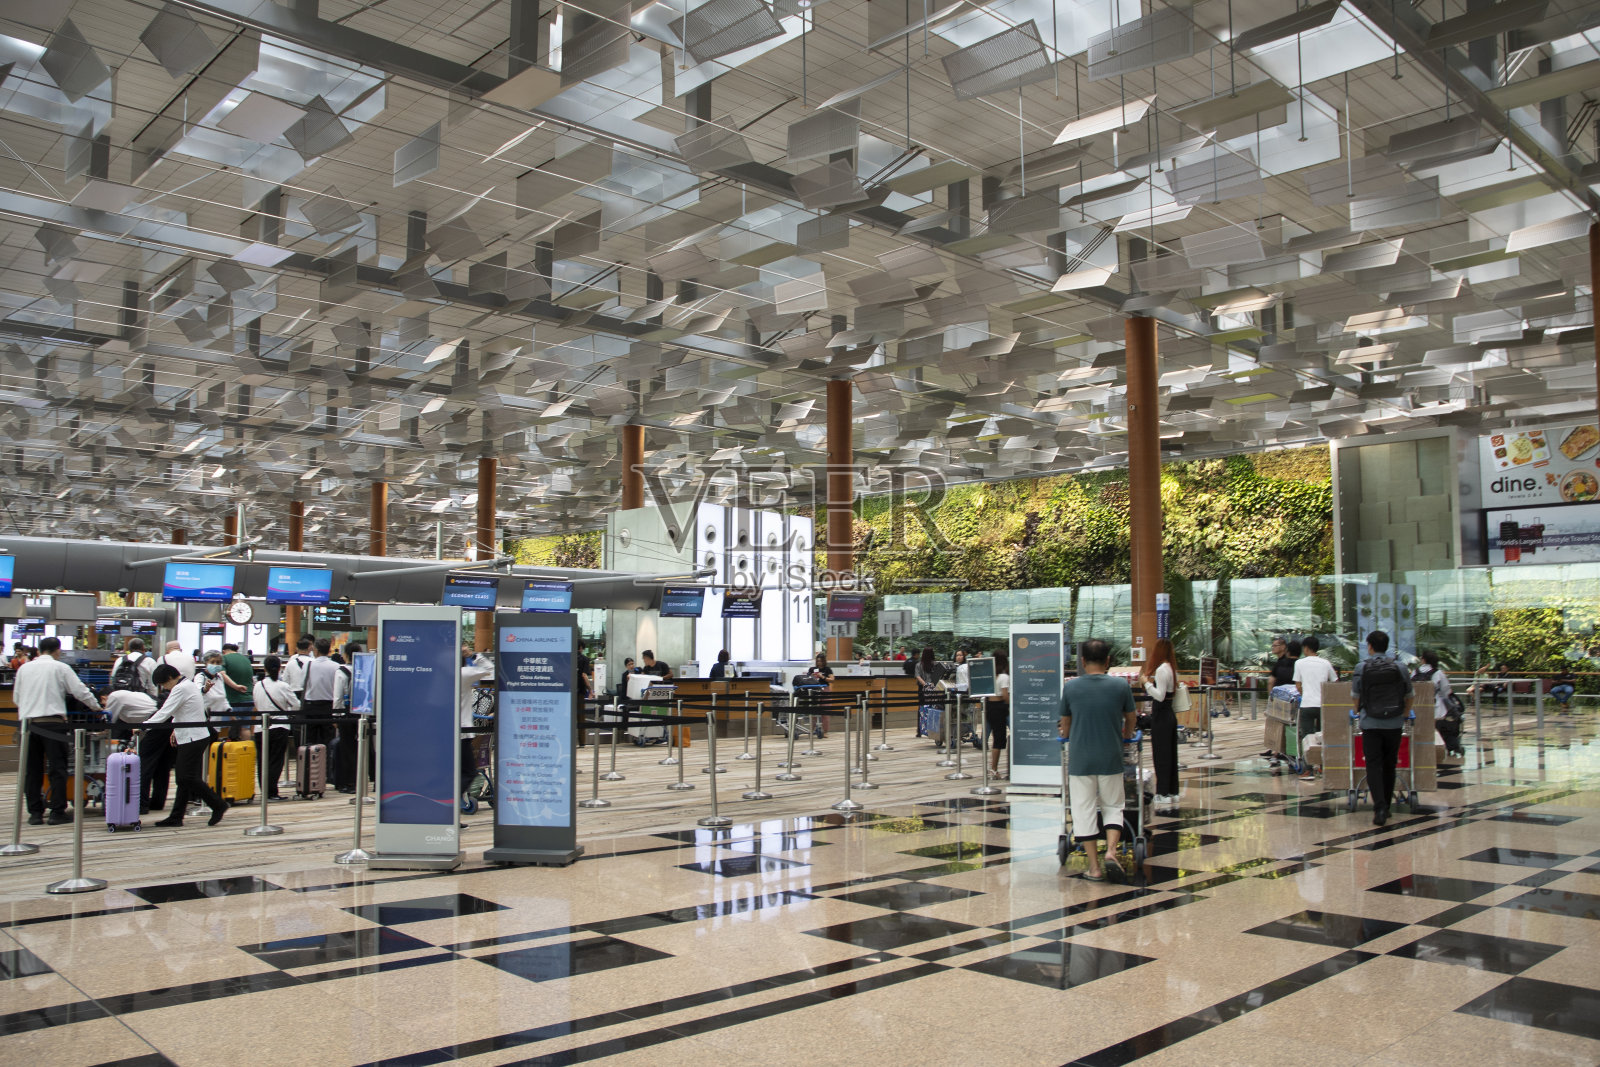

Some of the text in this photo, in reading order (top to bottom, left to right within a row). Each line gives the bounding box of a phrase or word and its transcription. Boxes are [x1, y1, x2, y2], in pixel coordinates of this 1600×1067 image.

[1490, 476, 1542, 493] dine.
[1519, 538, 1542, 546] Largest
[793, 594, 810, 624] 11
[254, 624, 262, 635] 9
